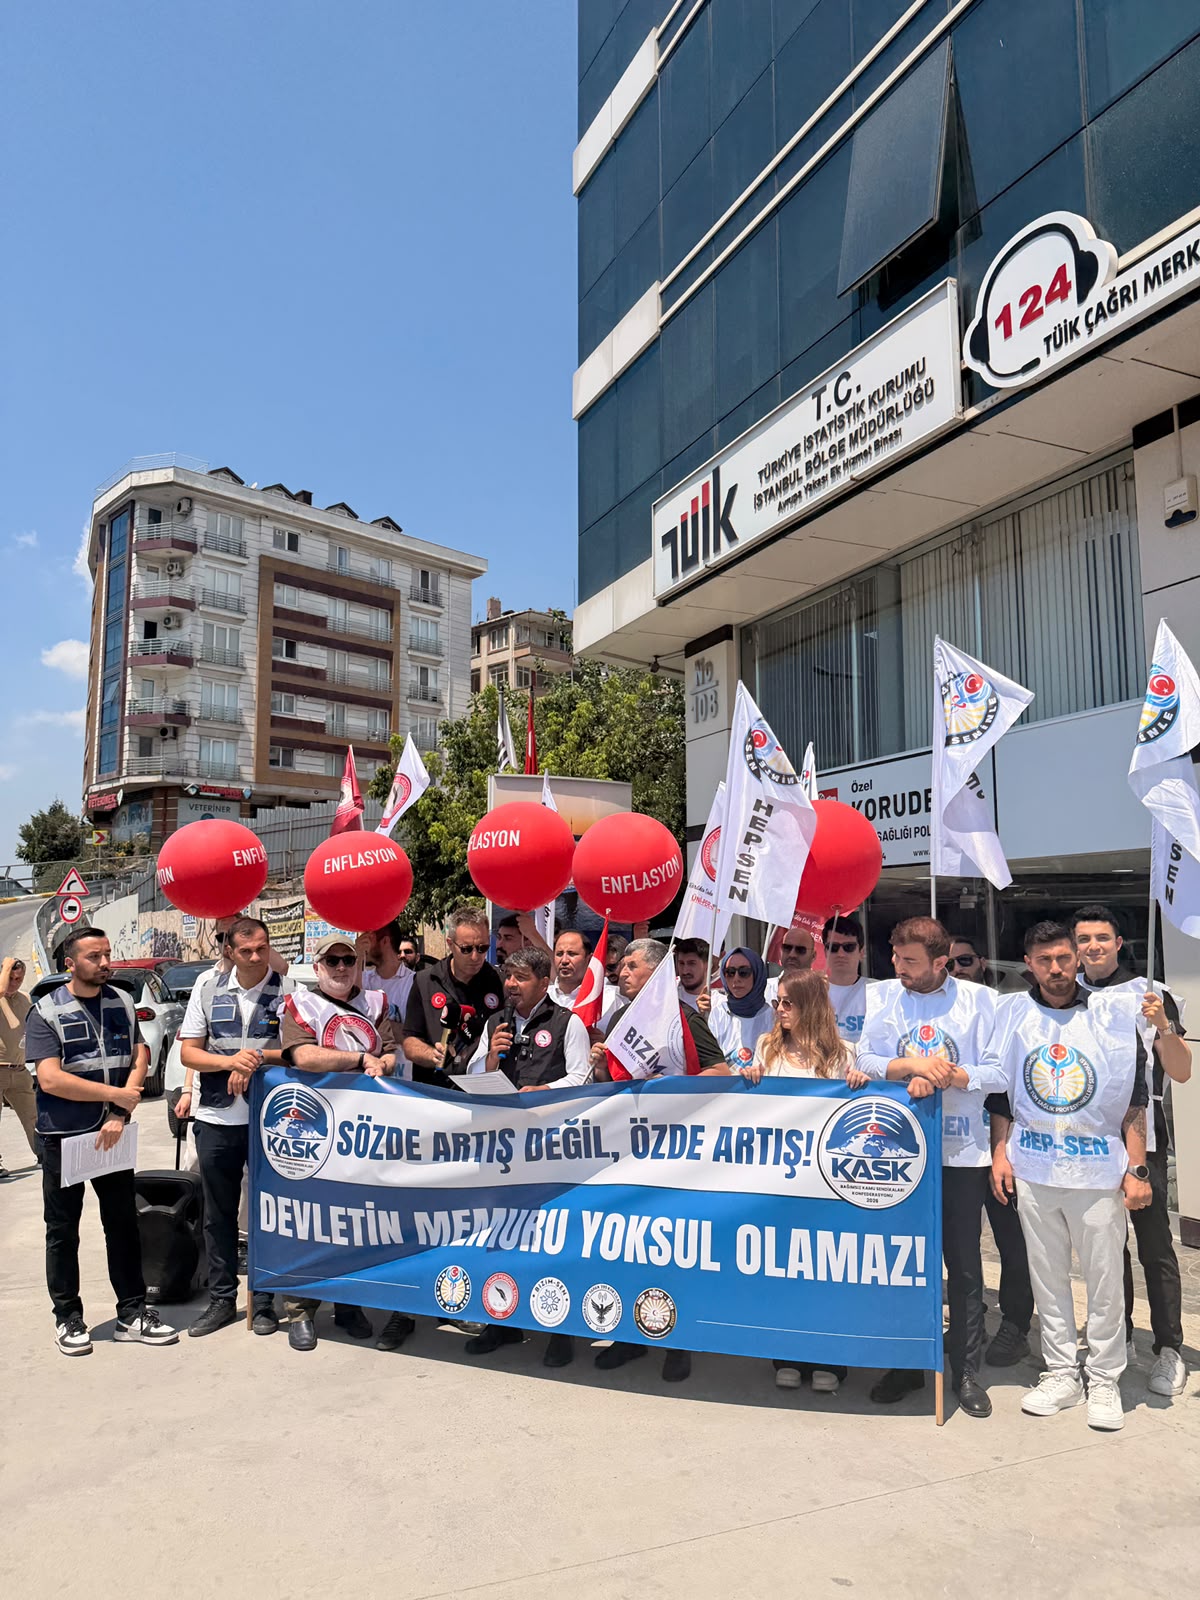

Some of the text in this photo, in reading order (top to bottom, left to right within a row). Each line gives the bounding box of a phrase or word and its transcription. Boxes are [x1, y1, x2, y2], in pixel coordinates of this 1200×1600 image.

[994, 262, 1072, 341] 124
[1043, 316, 1080, 356] TÜİK
[1084, 280, 1138, 334] ÇAĞRI
[811, 371, 862, 421] T.C.
[753, 377, 935, 512] İSTANBUL BÖLGE MÜDÜRLÜĞÜ
[757, 357, 926, 487] TÜRKİYE İSTATİSTİK KURUMU
[189, 803, 231, 813] VETERİNER
[851, 779, 873, 793] Özel
[323, 847, 398, 875] ENFLASYON
[601, 854, 680, 895] ENFLASYON
[728, 798, 774, 903] HEP-SEN
[267, 1134, 321, 1161] KASK
[337, 1115, 815, 1179] SÖZDE ARTIŞ DEĞİL, ÖZDE ARTIŞ!
[1019, 1128, 1110, 1156] HEP-SEN
[831, 1157, 913, 1182] KASK
[259, 1190, 927, 1287] DEVLETİN MEMURU YOKSUL OLAMAZ!
